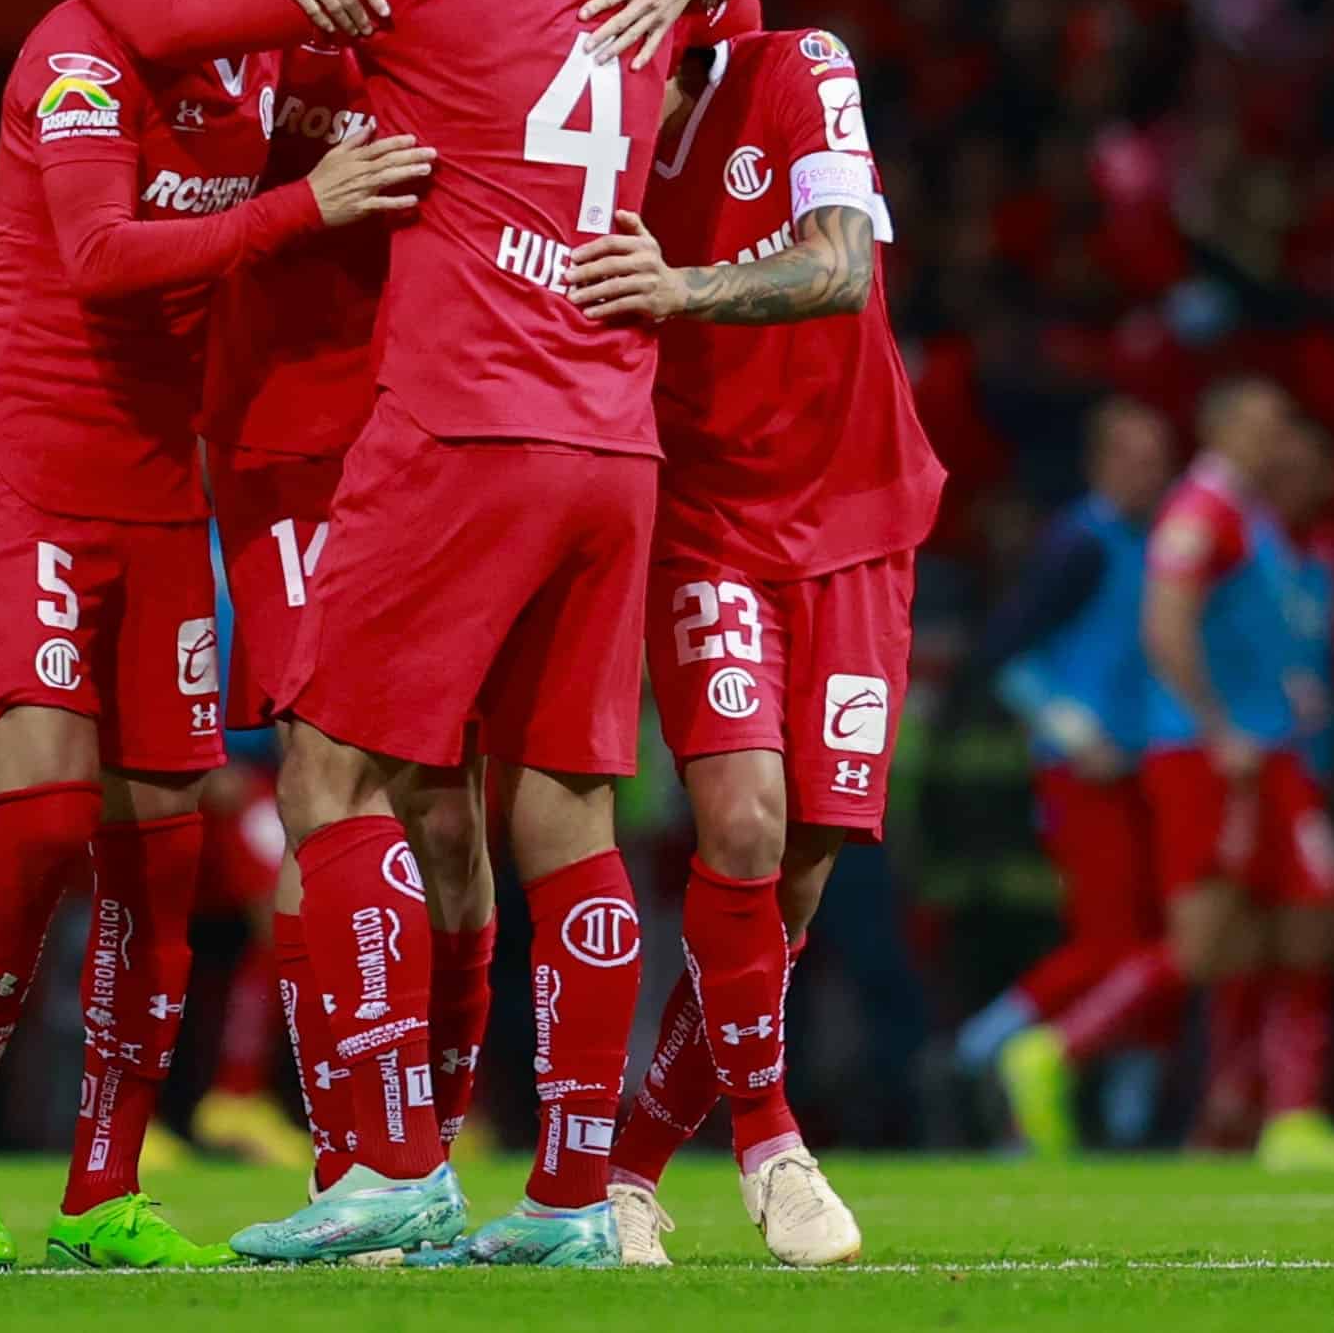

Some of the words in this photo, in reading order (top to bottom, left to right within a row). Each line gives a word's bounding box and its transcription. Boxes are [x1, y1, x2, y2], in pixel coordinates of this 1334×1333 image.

[524, 31, 631, 234] 4
[37, 540, 79, 631] 5
[672, 580, 763, 666] 23
[90, 898, 120, 1008] AEROMEXICO
[352, 907, 387, 1000] AEROMEXICO
[535, 964, 550, 1056] AEROMEXICO
